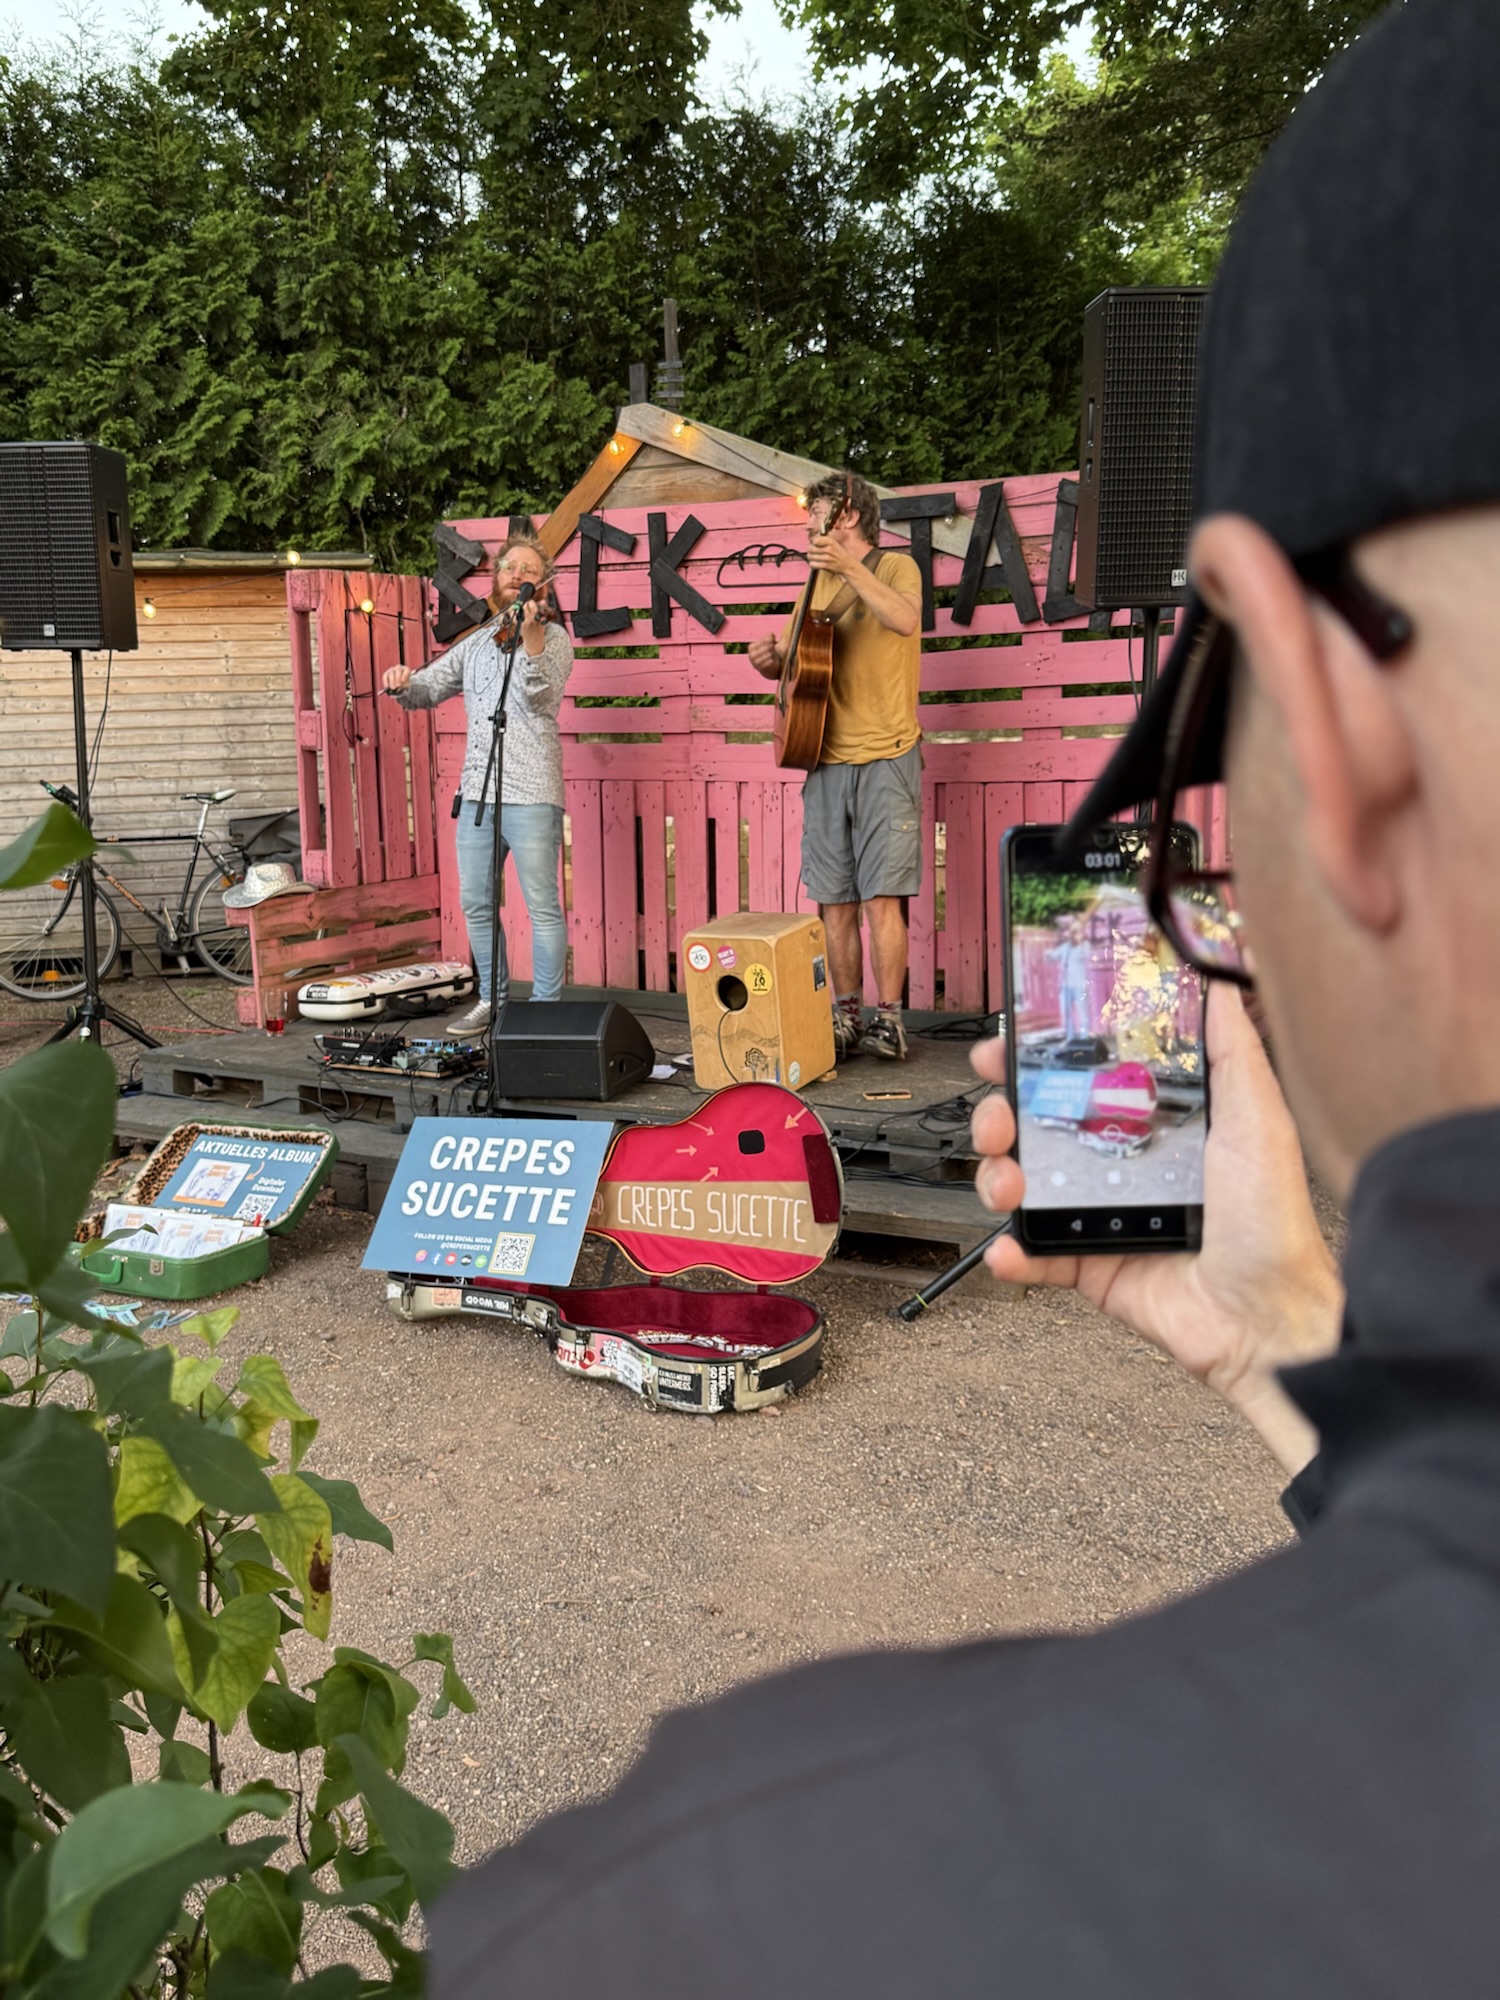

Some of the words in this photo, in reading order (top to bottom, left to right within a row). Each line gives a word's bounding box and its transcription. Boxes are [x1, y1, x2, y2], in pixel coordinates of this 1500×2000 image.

[194, 1140, 268, 1160] AKTUELLES
[267, 1148, 317, 1165] ALBUM
[429, 1135, 575, 1176] CREPES
[258, 1177, 287, 1186] Digitaler
[251, 1184, 285, 1193] Download
[401, 1180, 577, 1225] SUCETTE
[617, 1185, 695, 1231] CREPES
[706, 1191, 808, 1243] SUCETTE
[414, 1232, 436, 1240] FOLLOW
[454, 1235, 474, 1243] SOCIAL
[475, 1236, 493, 1244] MEDIA
[440, 1242, 491, 1252] @CREPESSUCETTE
[466, 1295, 493, 1308] WOOD
[710, 1367, 718, 1379] GO
